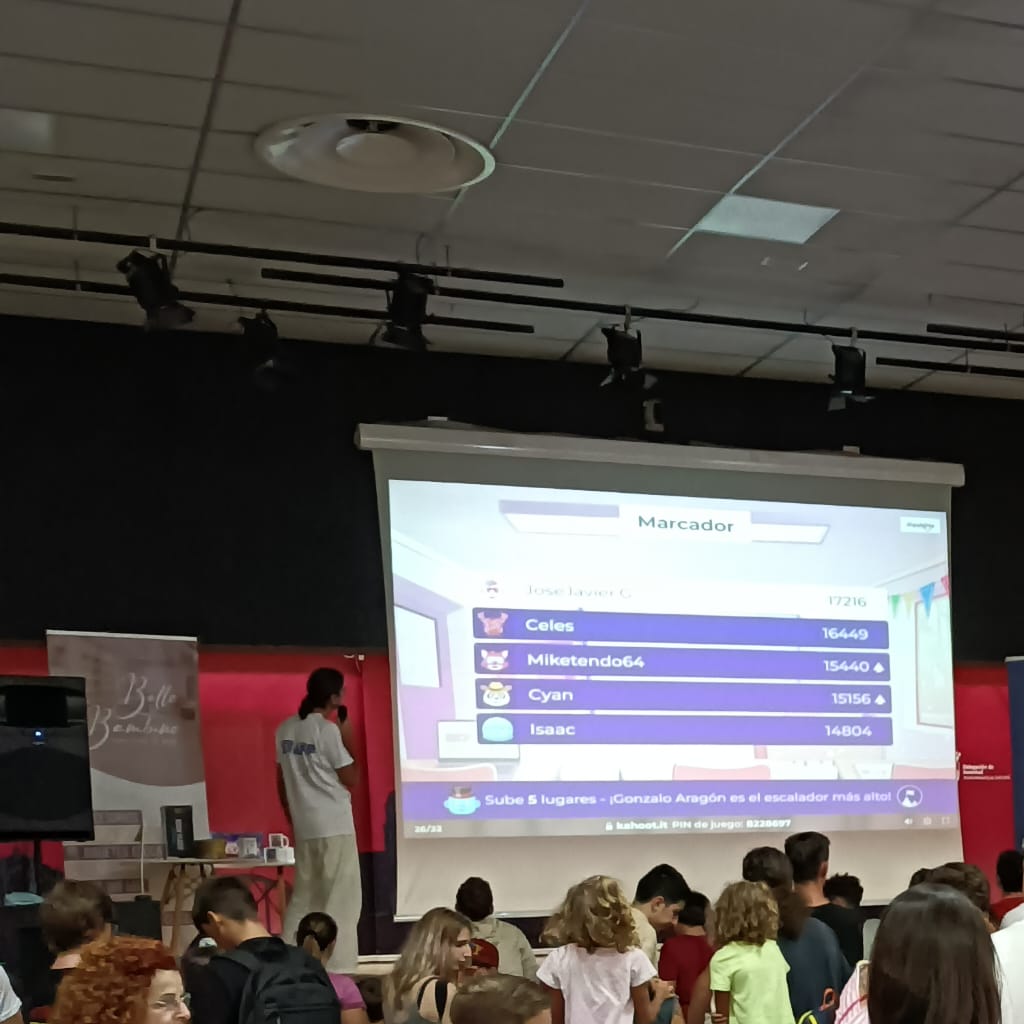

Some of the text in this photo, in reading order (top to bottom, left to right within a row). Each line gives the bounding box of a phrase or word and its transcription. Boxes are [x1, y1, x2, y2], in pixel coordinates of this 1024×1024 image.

[638, 515, 734, 532] Marcador
[829, 595, 867, 607] 17216
[525, 618, 575, 633] Celes
[822, 627, 869, 641] 16449
[527, 653, 645, 668] Miketendo64
[823, 660, 870, 673] 15440
[528, 688, 574, 703] Cyan
[832, 693, 871, 705] 15156
[530, 723, 575, 736] Isaac
[825, 724, 873, 737] 14804
[485, 795, 524, 806] Sube
[527, 795, 537, 805] 5
[541, 794, 597, 808] lugares
[730, 794, 746, 803] es
[749, 792, 761, 803] el
[764, 791, 829, 804] escalador
[672, 820, 692, 829] PIN
